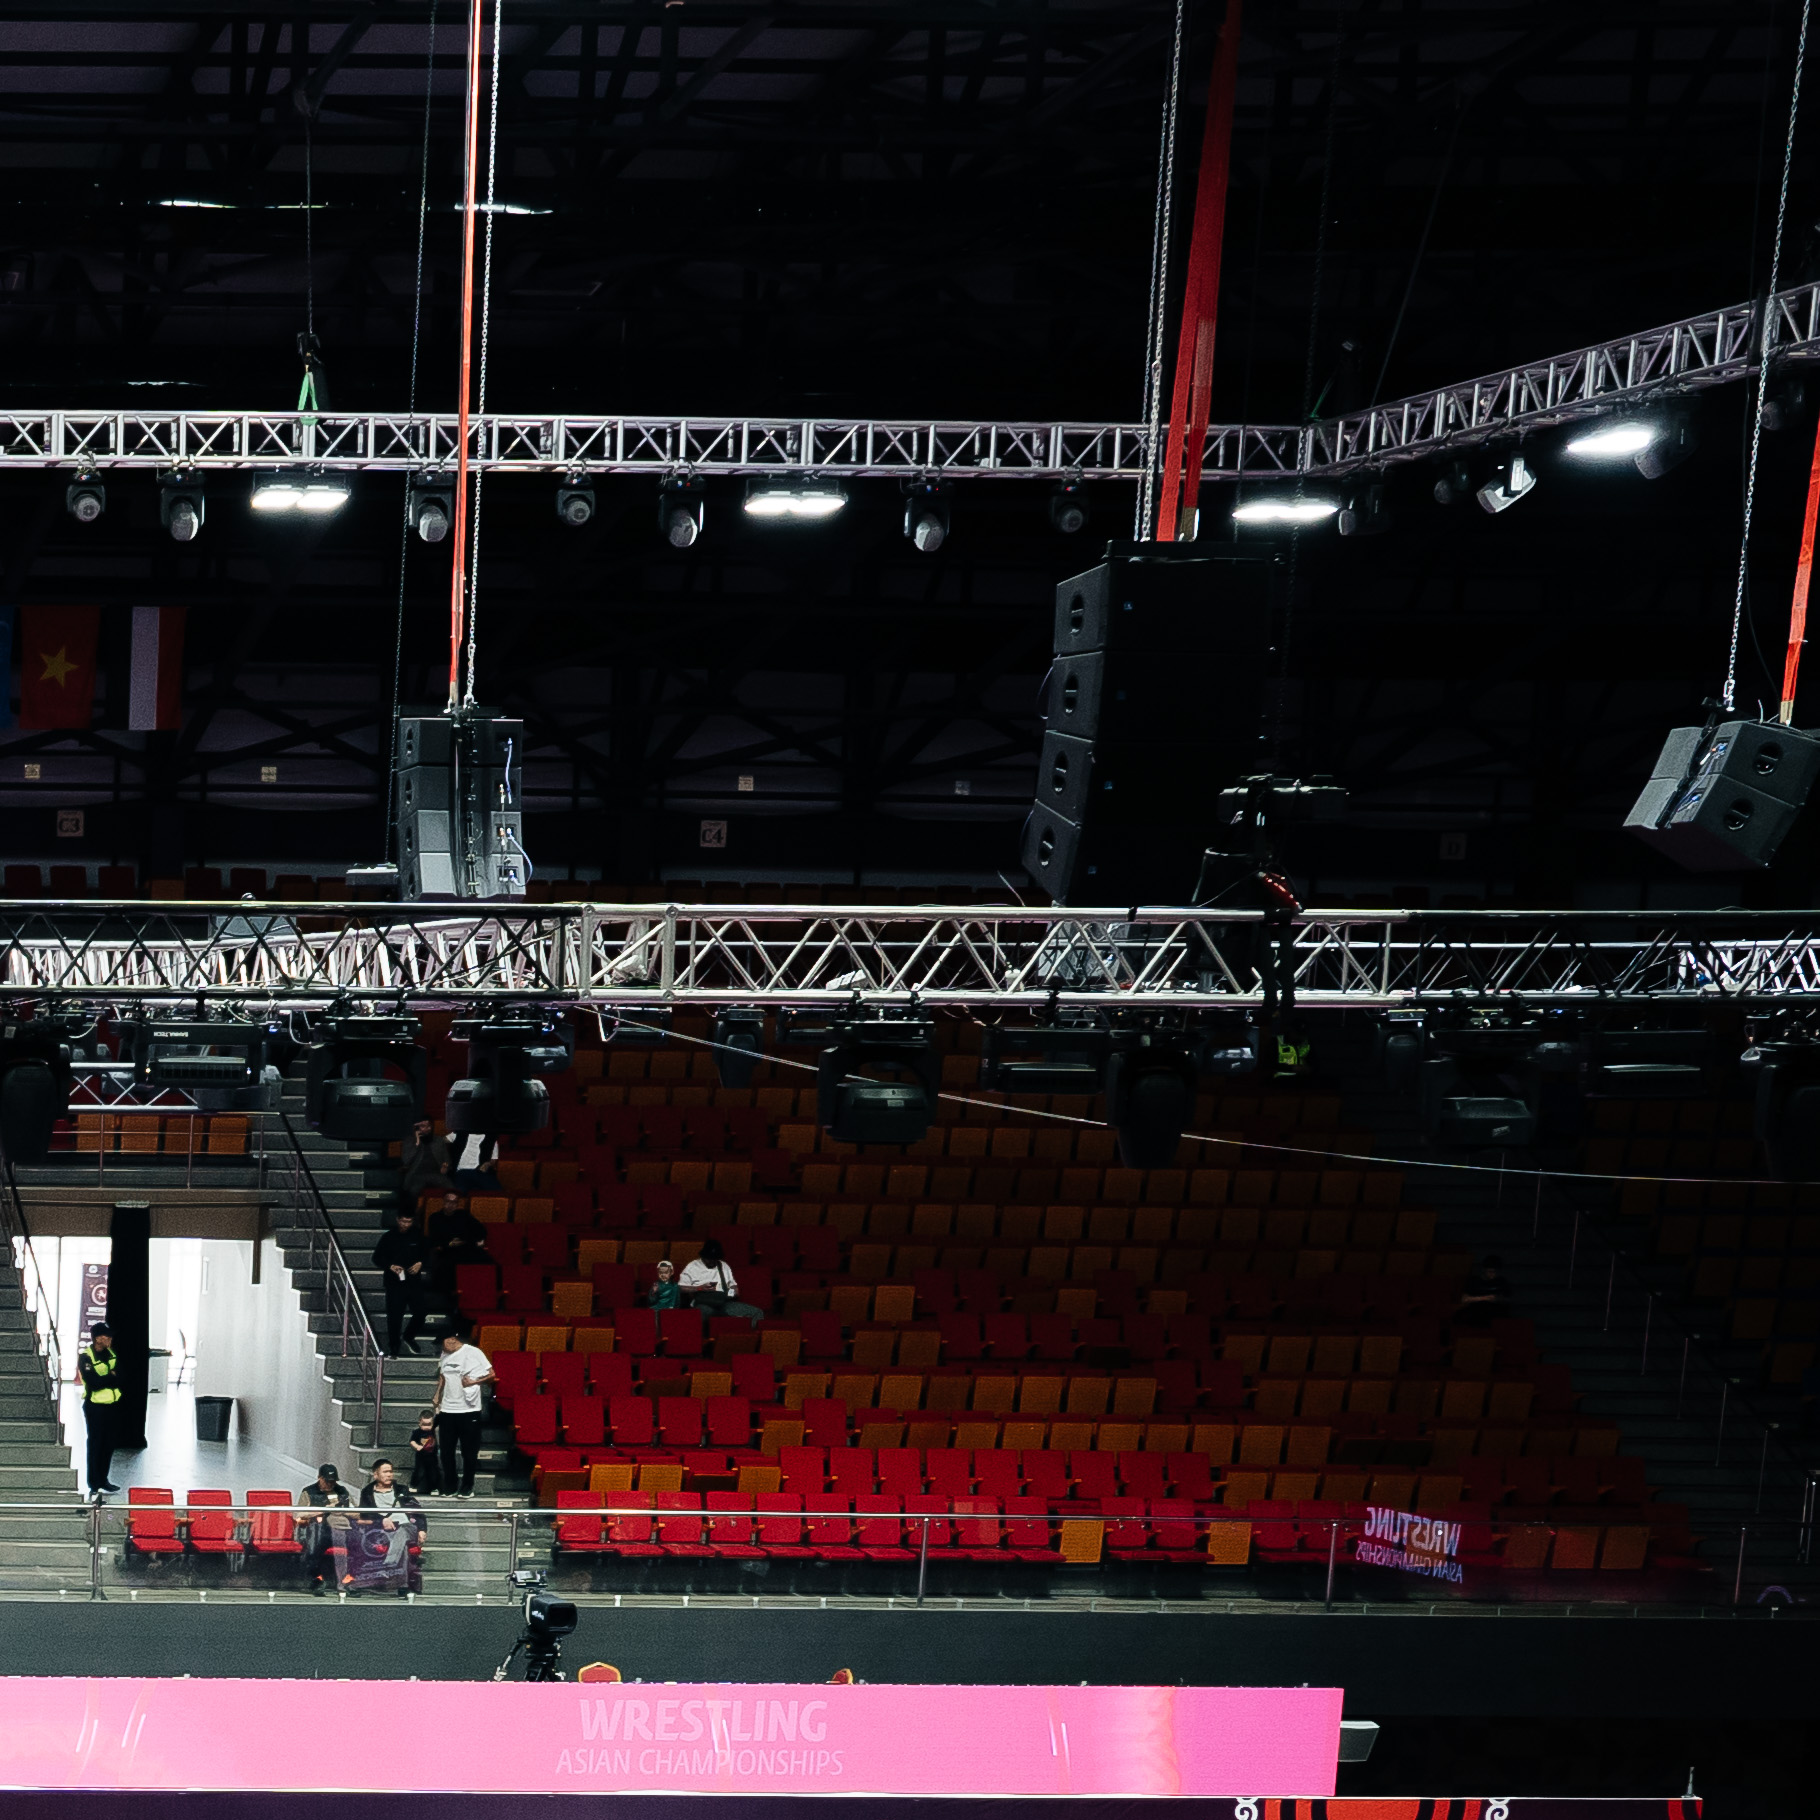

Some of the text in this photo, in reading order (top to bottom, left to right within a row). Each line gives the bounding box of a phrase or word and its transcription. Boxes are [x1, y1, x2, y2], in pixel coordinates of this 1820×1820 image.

[579, 1699, 827, 1743] WRESTLING
[555, 1749, 844, 1776] ASIAN CHAMPIONSHIPS
